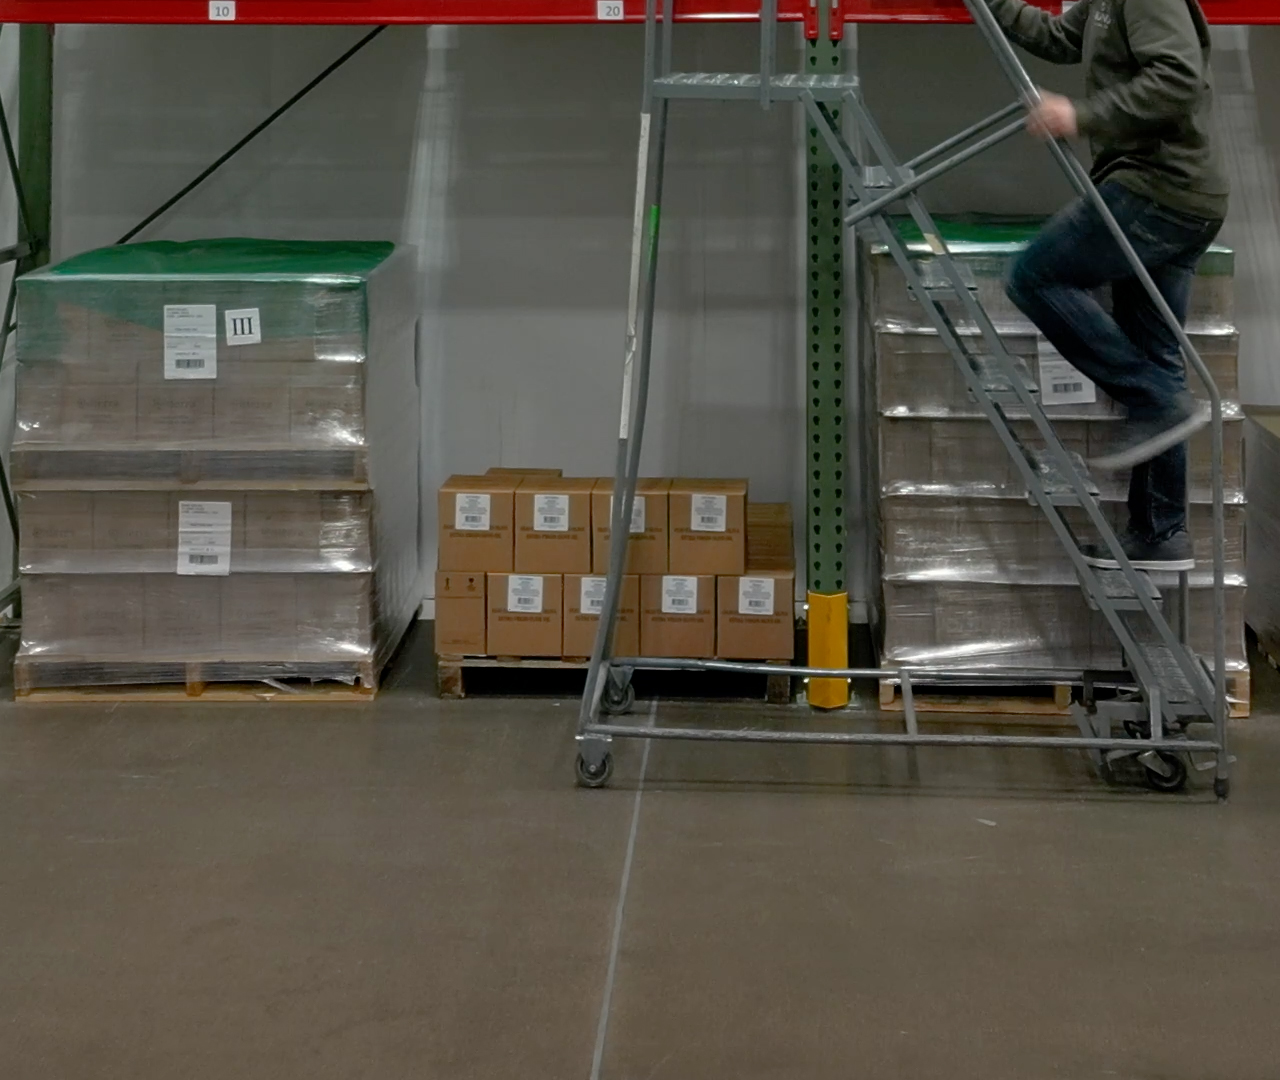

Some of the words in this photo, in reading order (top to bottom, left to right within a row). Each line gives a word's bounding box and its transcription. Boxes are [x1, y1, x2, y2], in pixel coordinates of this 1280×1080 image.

[215, 6, 230, 17] 10
[605, 5, 620, 17] 20
[231, 316, 254, 336] III
